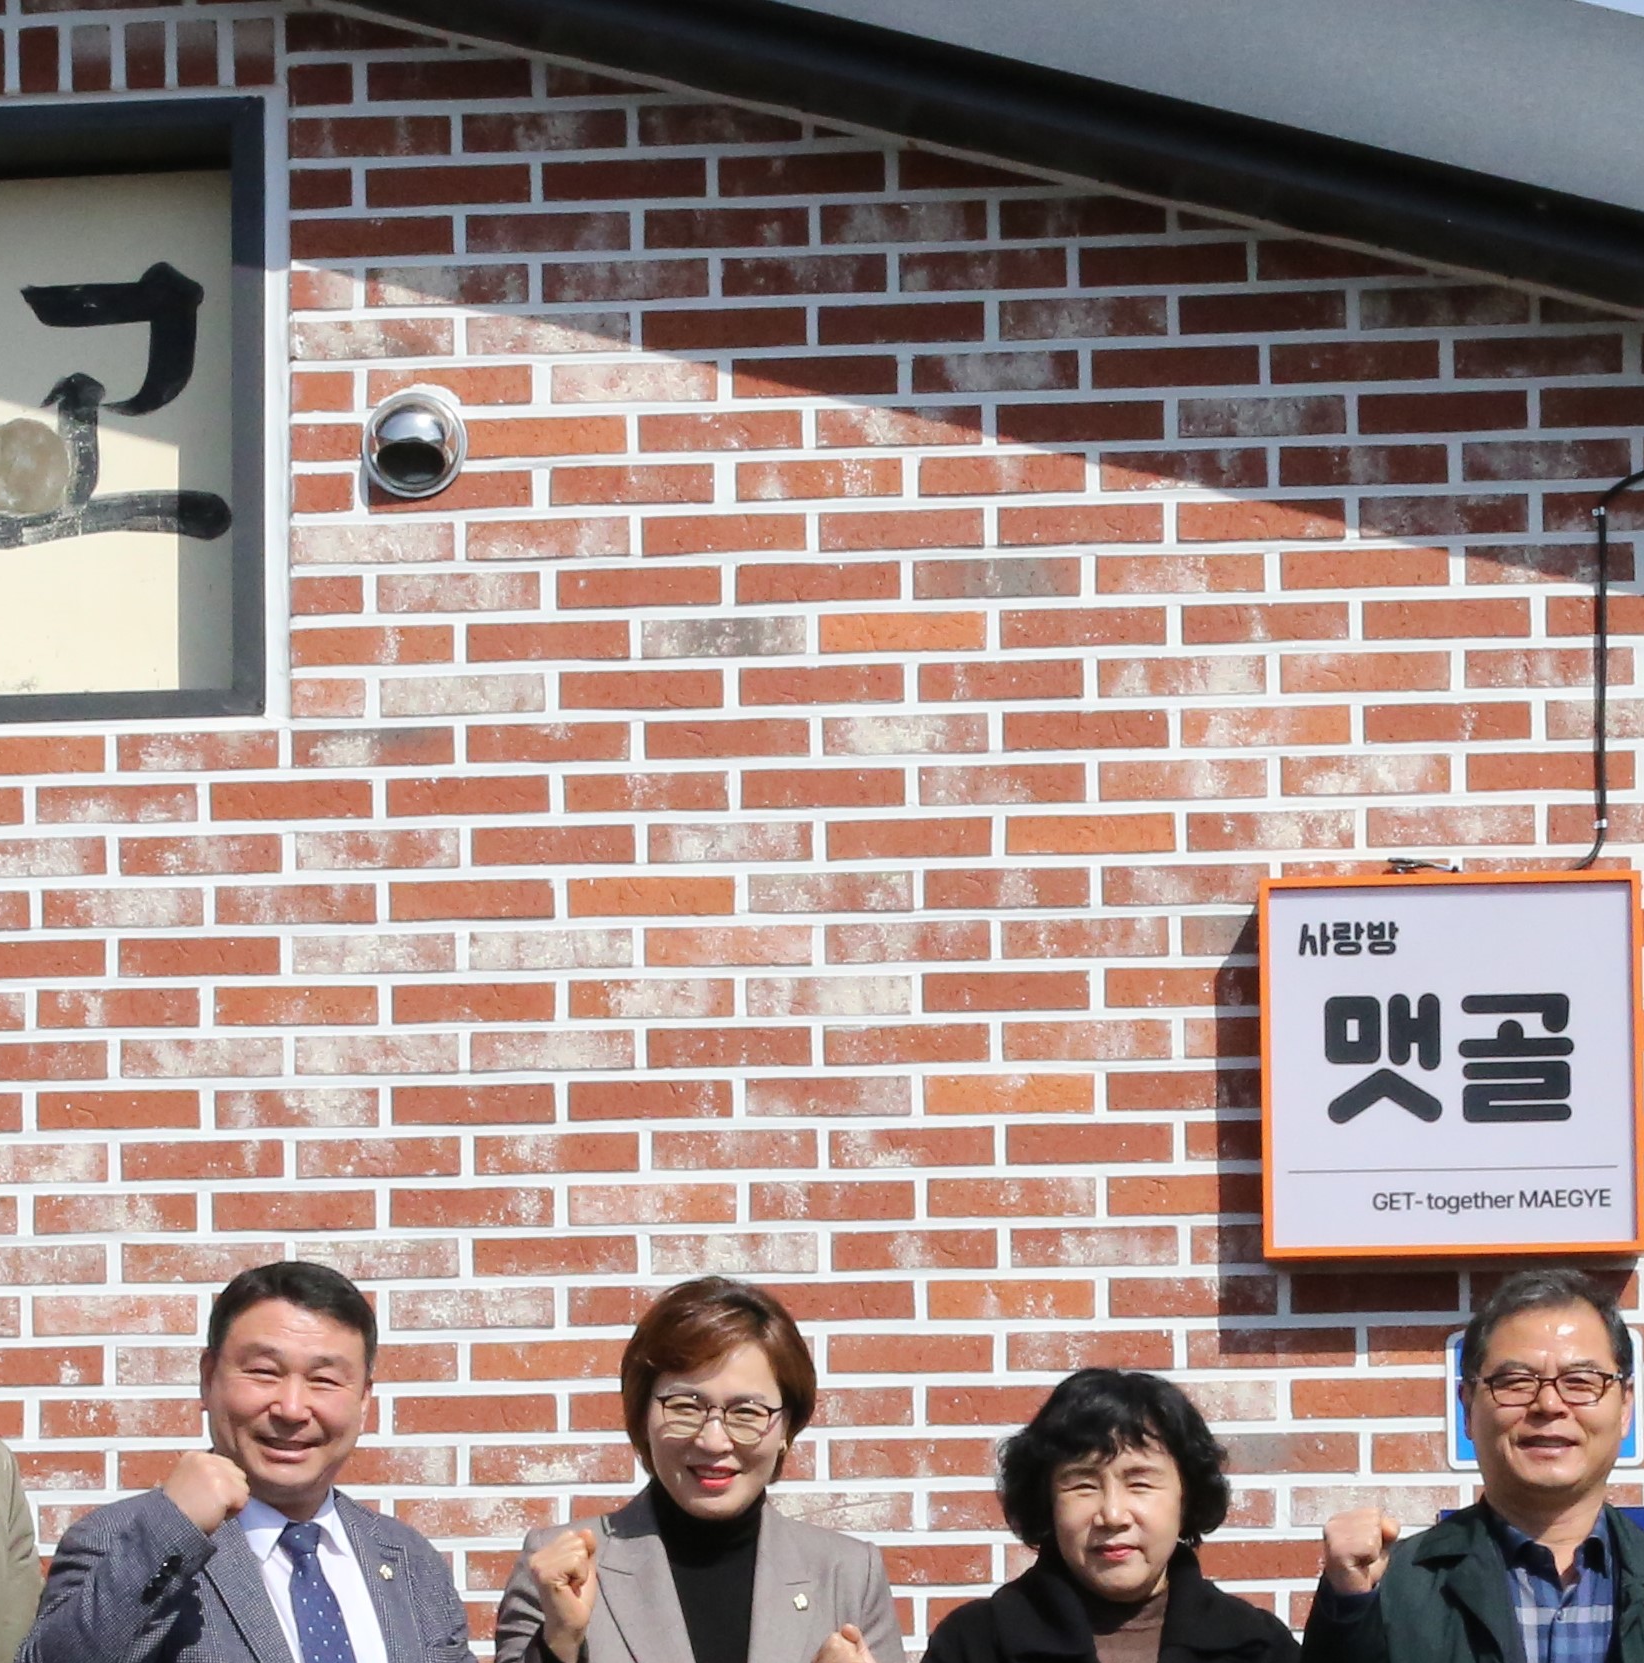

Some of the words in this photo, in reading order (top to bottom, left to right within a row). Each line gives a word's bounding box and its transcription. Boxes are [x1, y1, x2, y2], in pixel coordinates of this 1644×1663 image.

[1298, 921, 1399, 957] 사랑방
[1324, 992, 1575, 1125] 맷골
[1519, 1188, 1611, 1208] MAEGYE
